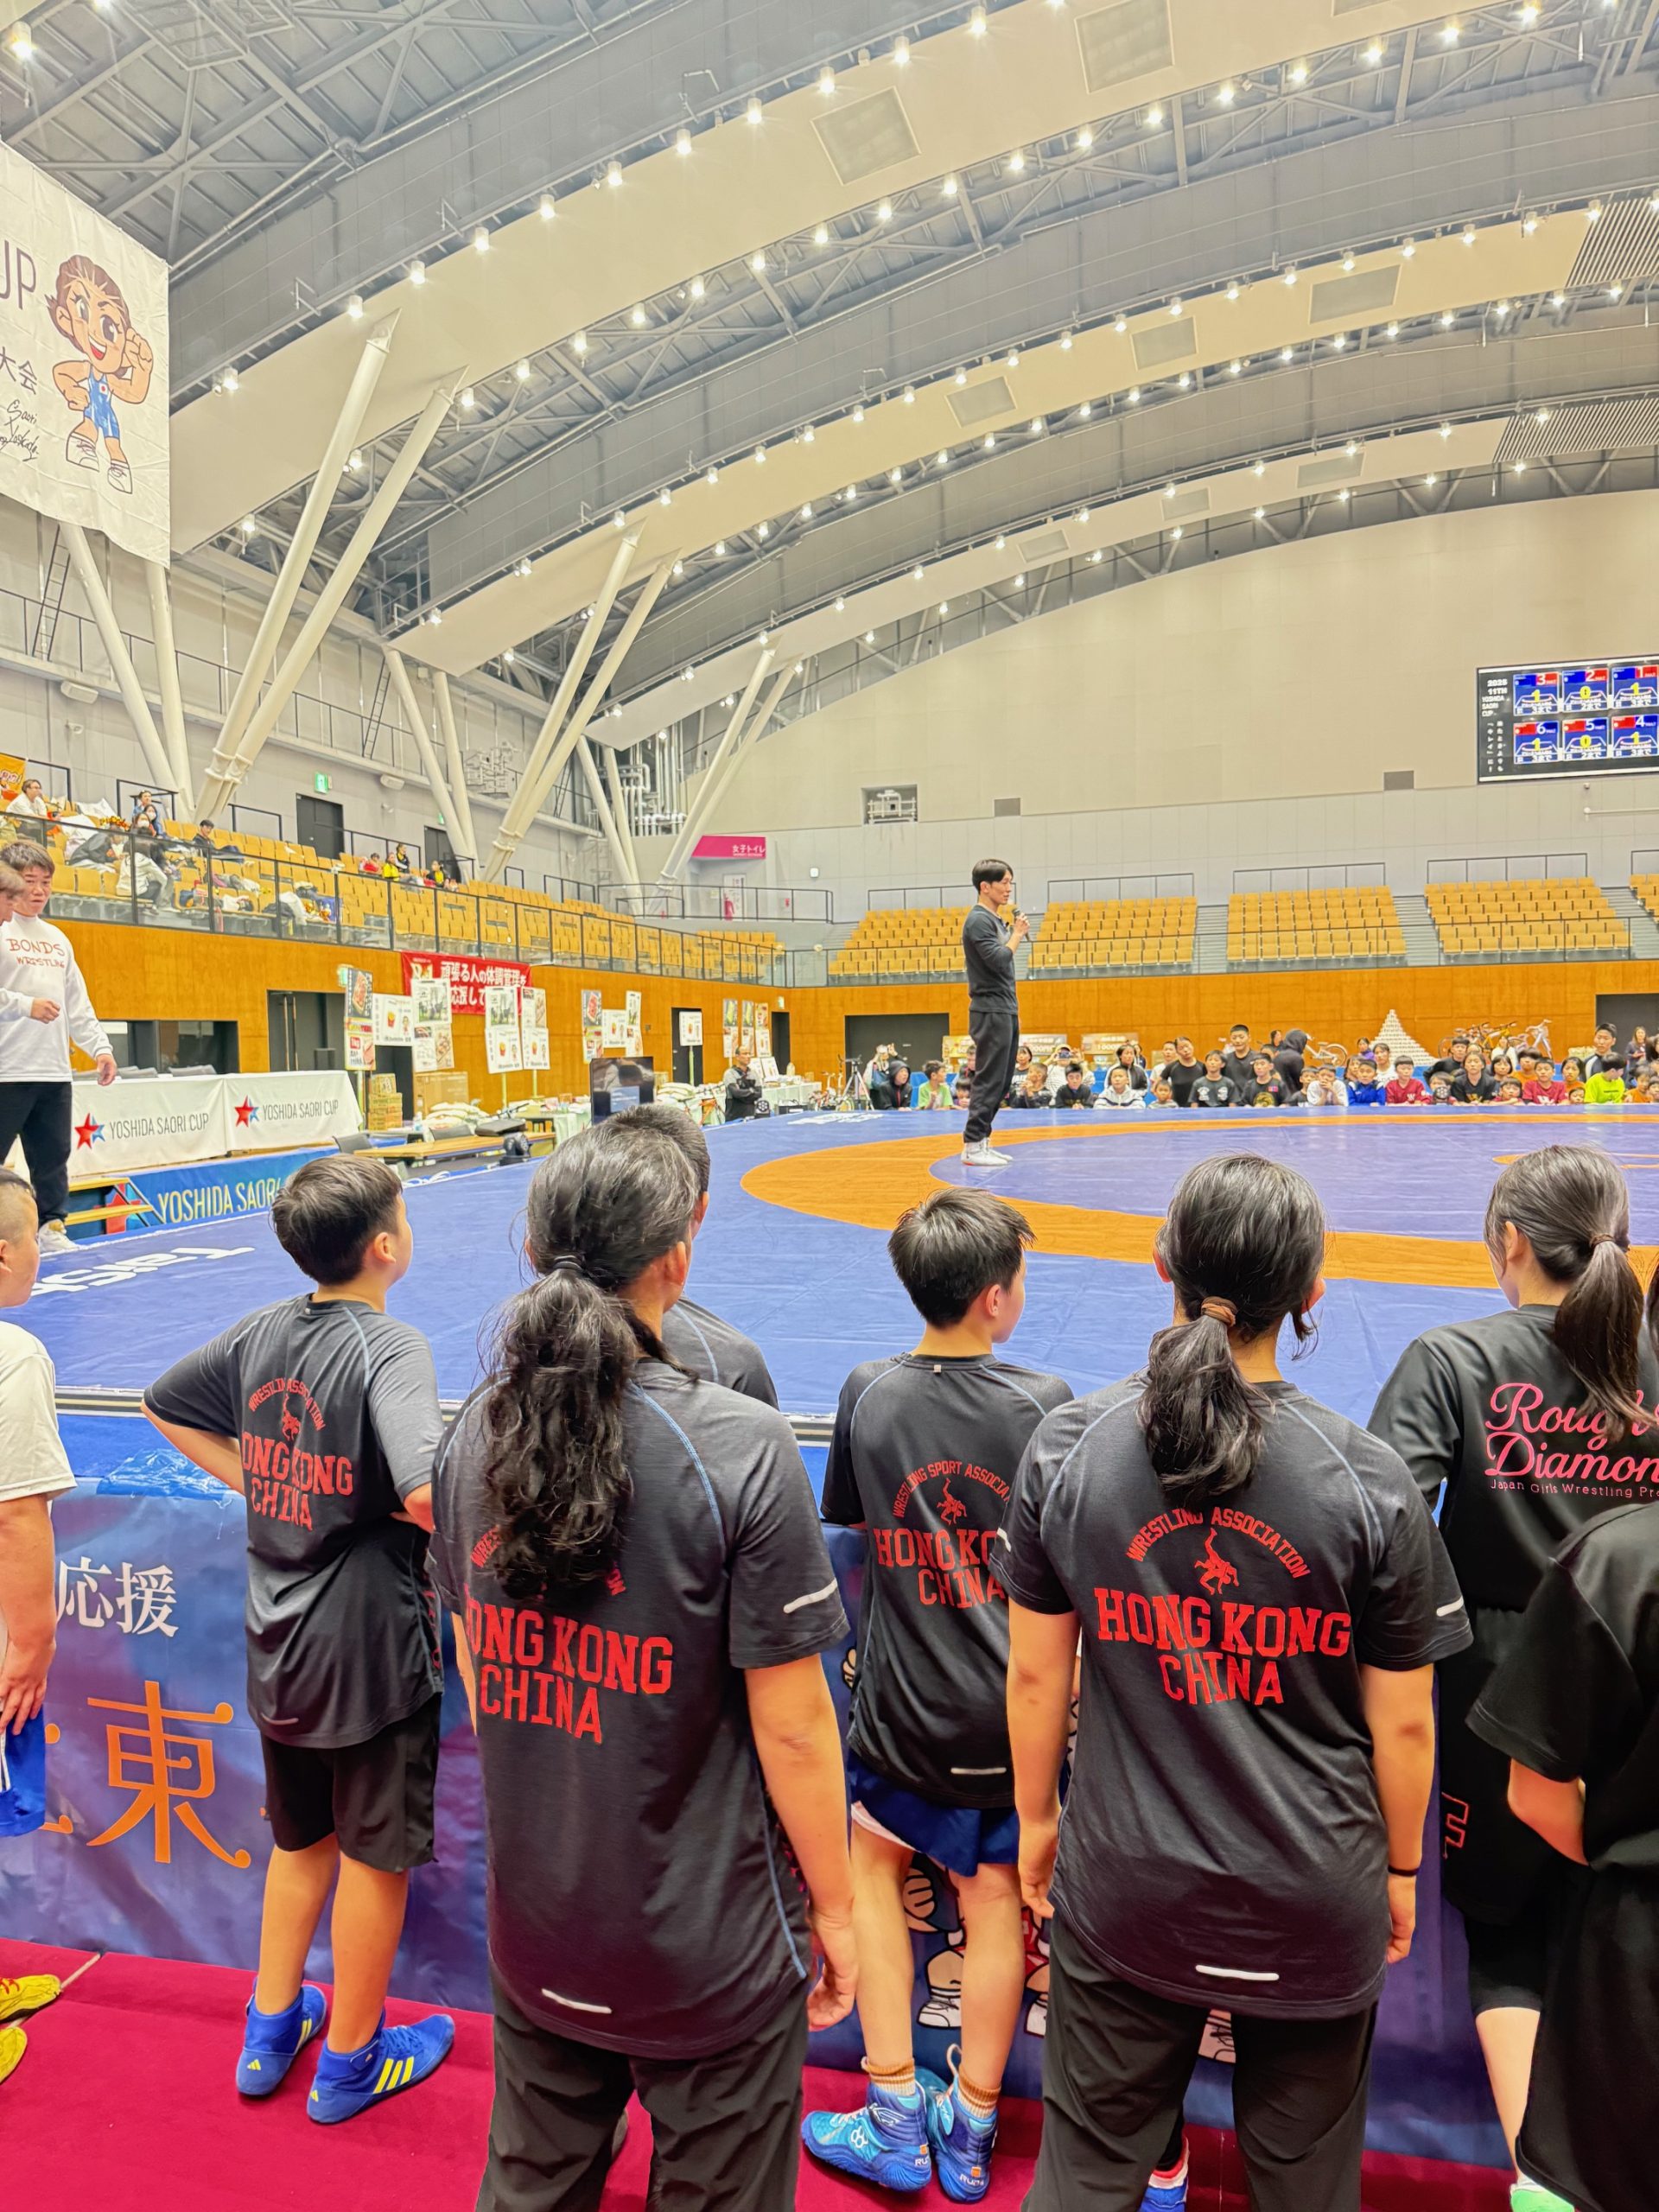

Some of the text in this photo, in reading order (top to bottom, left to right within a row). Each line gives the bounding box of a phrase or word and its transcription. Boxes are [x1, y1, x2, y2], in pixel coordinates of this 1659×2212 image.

[1537, 673, 1546, 685] 3
[1586, 669, 1595, 682] 2
[1537, 721, 1546, 734] 6
[1586, 718, 1595, 731] 5
[1636, 715, 1645, 728] 4
[6, 938, 65, 957] BONDS
[110, 1113, 209, 1140] YOSHIDA SAORI CUP
[262, 1099, 339, 1121] YOSHIDA SAORI CUP
[157, 1185, 233, 1224] YOSHIDA
[242, 1431, 290, 1481] ONG
[892, 1460, 1011, 1518] WRESTLING SPORT ASSOCIA
[1490, 1479, 1525, 1491] Japan
[1530, 1483, 1559, 1494] Girls
[1561, 1483, 1633, 1498] Wrestling
[873, 1528, 956, 1572] HONG
[1211, 1506, 1311, 1579] ASSOCIATION
[57, 1556, 180, 1637] 応援
[918, 1567, 1006, 1609] CHINA
[1094, 1587, 1351, 1657] HONG KONG
[465, 1594, 544, 1668] ONG
[551, 1616, 673, 1695] KONG
[1159, 1650, 1284, 1706] CHINA
[480, 1663, 602, 1745] CHINA
